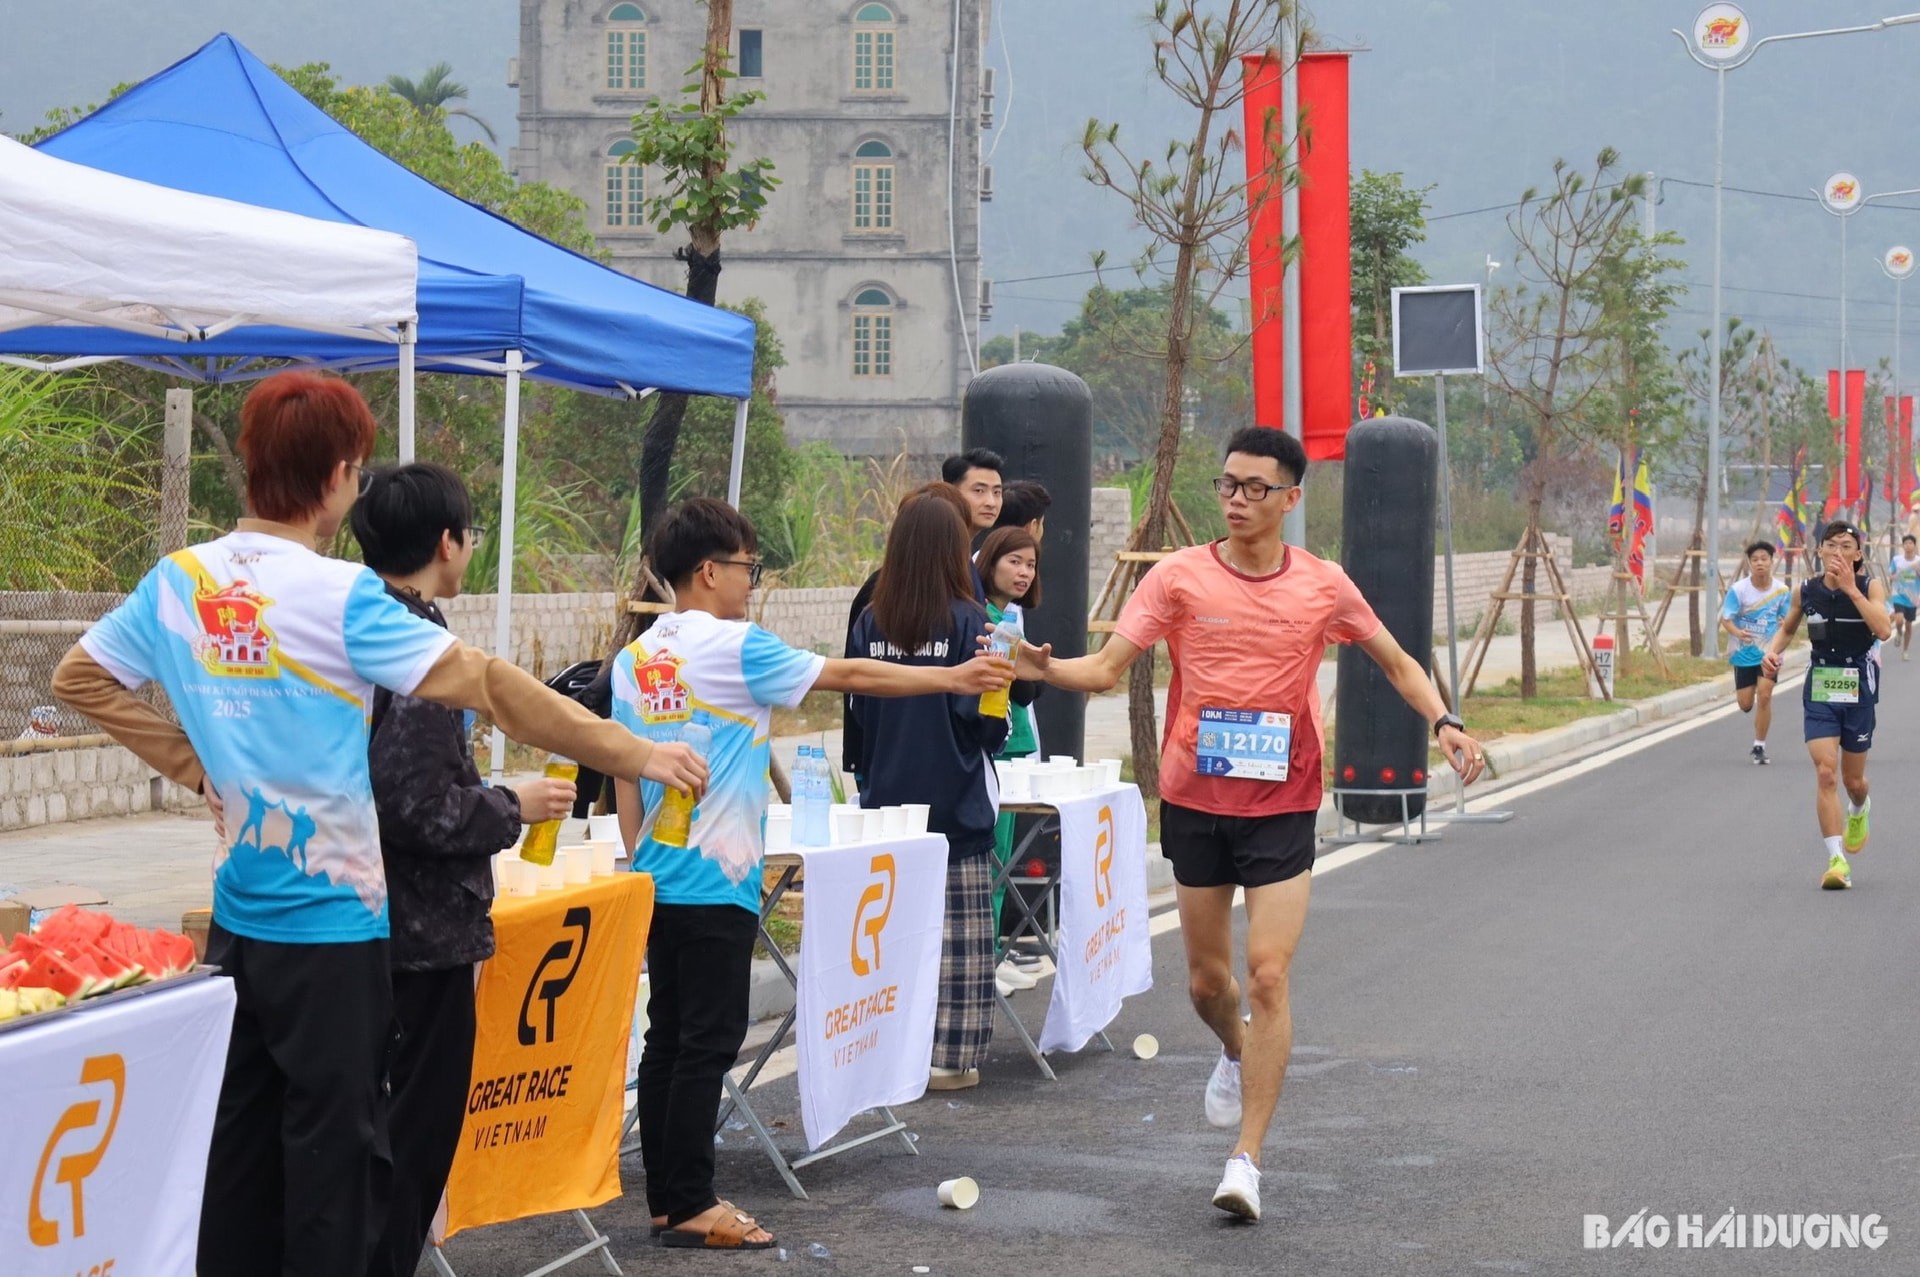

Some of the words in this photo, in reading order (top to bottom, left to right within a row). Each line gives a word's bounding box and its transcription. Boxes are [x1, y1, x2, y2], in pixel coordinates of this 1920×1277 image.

[869, 641, 886, 659] ĐẠI
[933, 637, 949, 658] ĐỎ
[1594, 651, 1611, 664] H7
[1823, 679, 1857, 690] 52259
[212, 699, 252, 719] 2025
[1200, 709, 1223, 720] 10KM
[1222, 731, 1286, 754] 12170
[1105, 908, 1126, 943] RACE
[824, 997, 867, 1041] GREAT
[833, 1027, 879, 1069] VIETNAM
[468, 1071, 527, 1115] GREAT
[526, 1064, 573, 1103] RACE
[473, 1114, 548, 1152] VIETNAM
